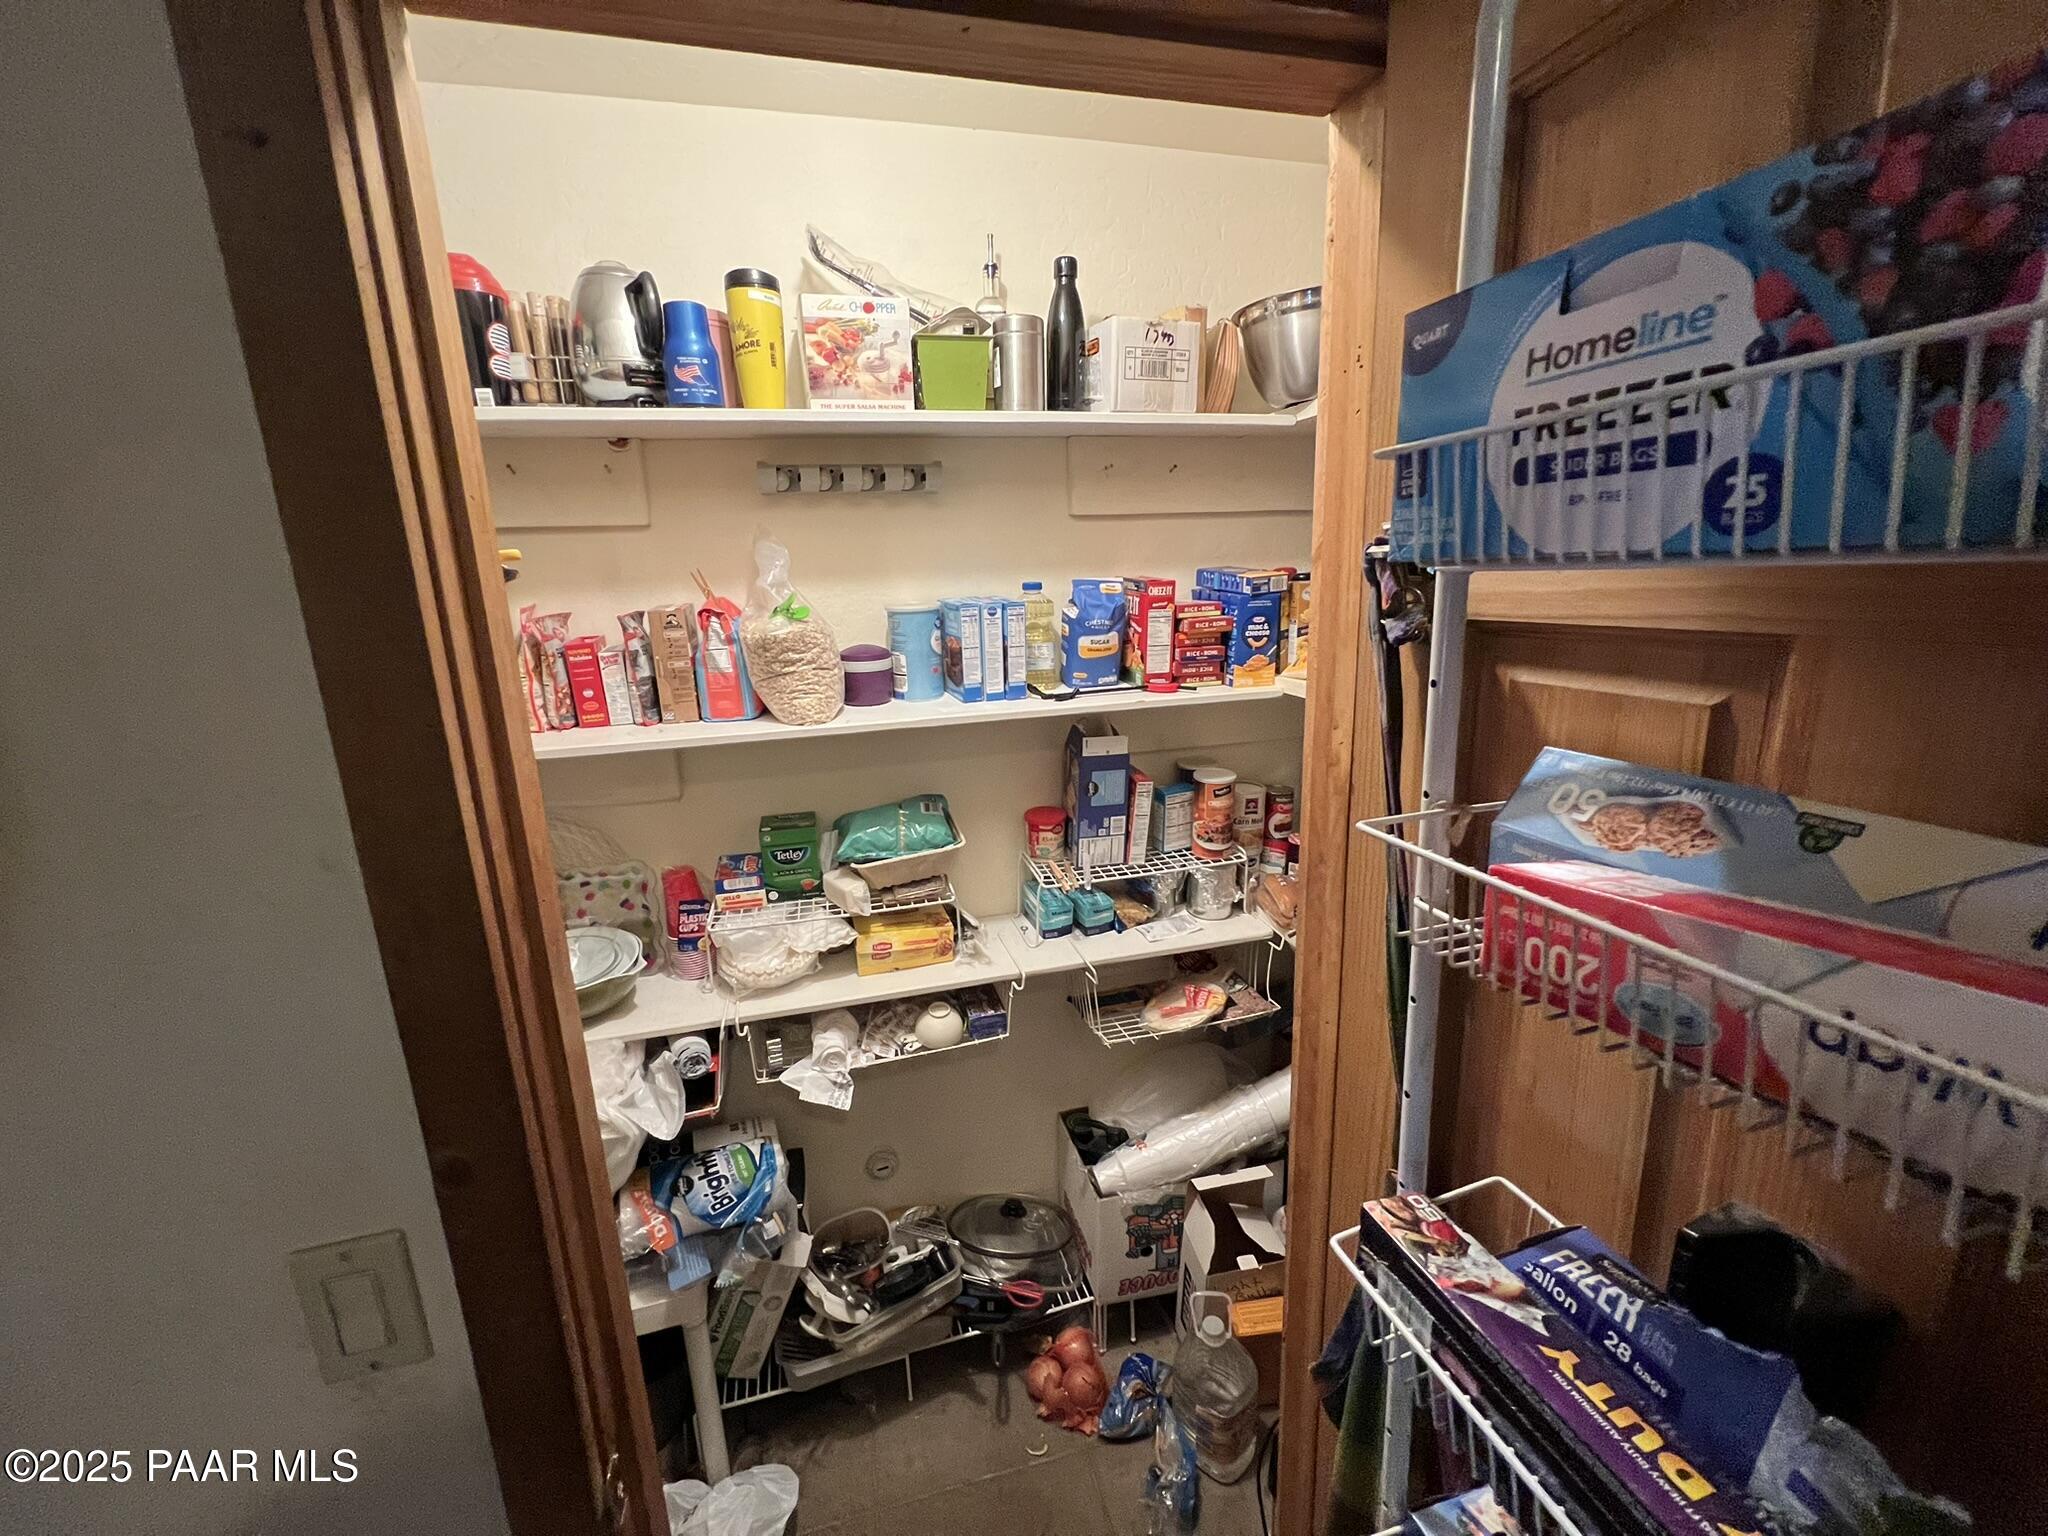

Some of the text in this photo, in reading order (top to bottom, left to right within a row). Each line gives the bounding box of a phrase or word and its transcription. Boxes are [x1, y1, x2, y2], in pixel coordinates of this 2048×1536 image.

[1525, 302, 1715, 379] Homeline
[1610, 446, 1657, 468] BGS
[1722, 472, 1769, 509] 25
[1546, 782, 1609, 823] 50
[774, 848, 805, 861] Tetley
[679, 923, 699, 933] CUPS
[1603, 1330, 1633, 1363] 28
[1632, 1361, 1669, 1399] bags
[1537, 1344, 1718, 1502] DUTY
[1569, 1390, 1622, 1441] ALUMINUM
[1619, 1440, 1651, 1470] DUTY
[1648, 1469, 1689, 1507] HEAVY
